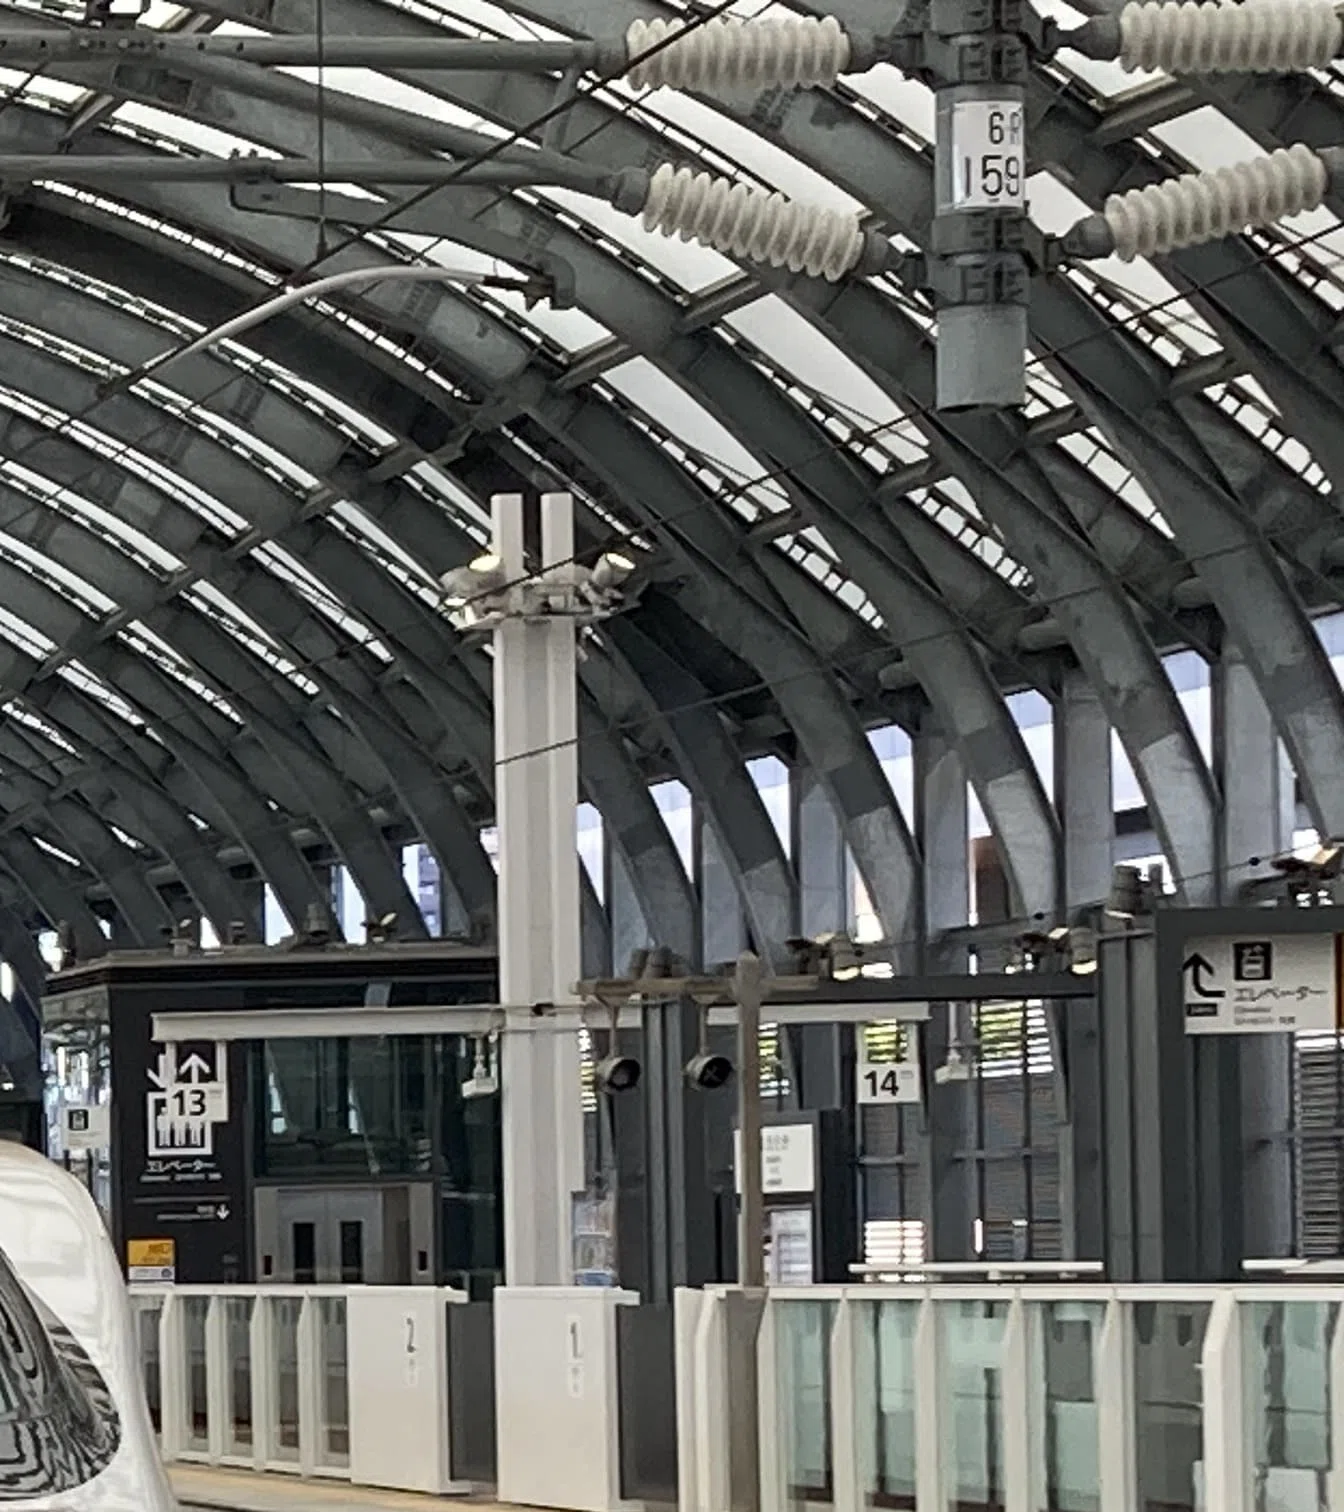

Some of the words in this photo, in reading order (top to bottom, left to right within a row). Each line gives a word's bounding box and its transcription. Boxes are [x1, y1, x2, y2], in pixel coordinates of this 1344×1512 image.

[964, 154, 1020, 197] 159
[863, 1069, 900, 1097] 14
[171, 1089, 206, 1117] 13
